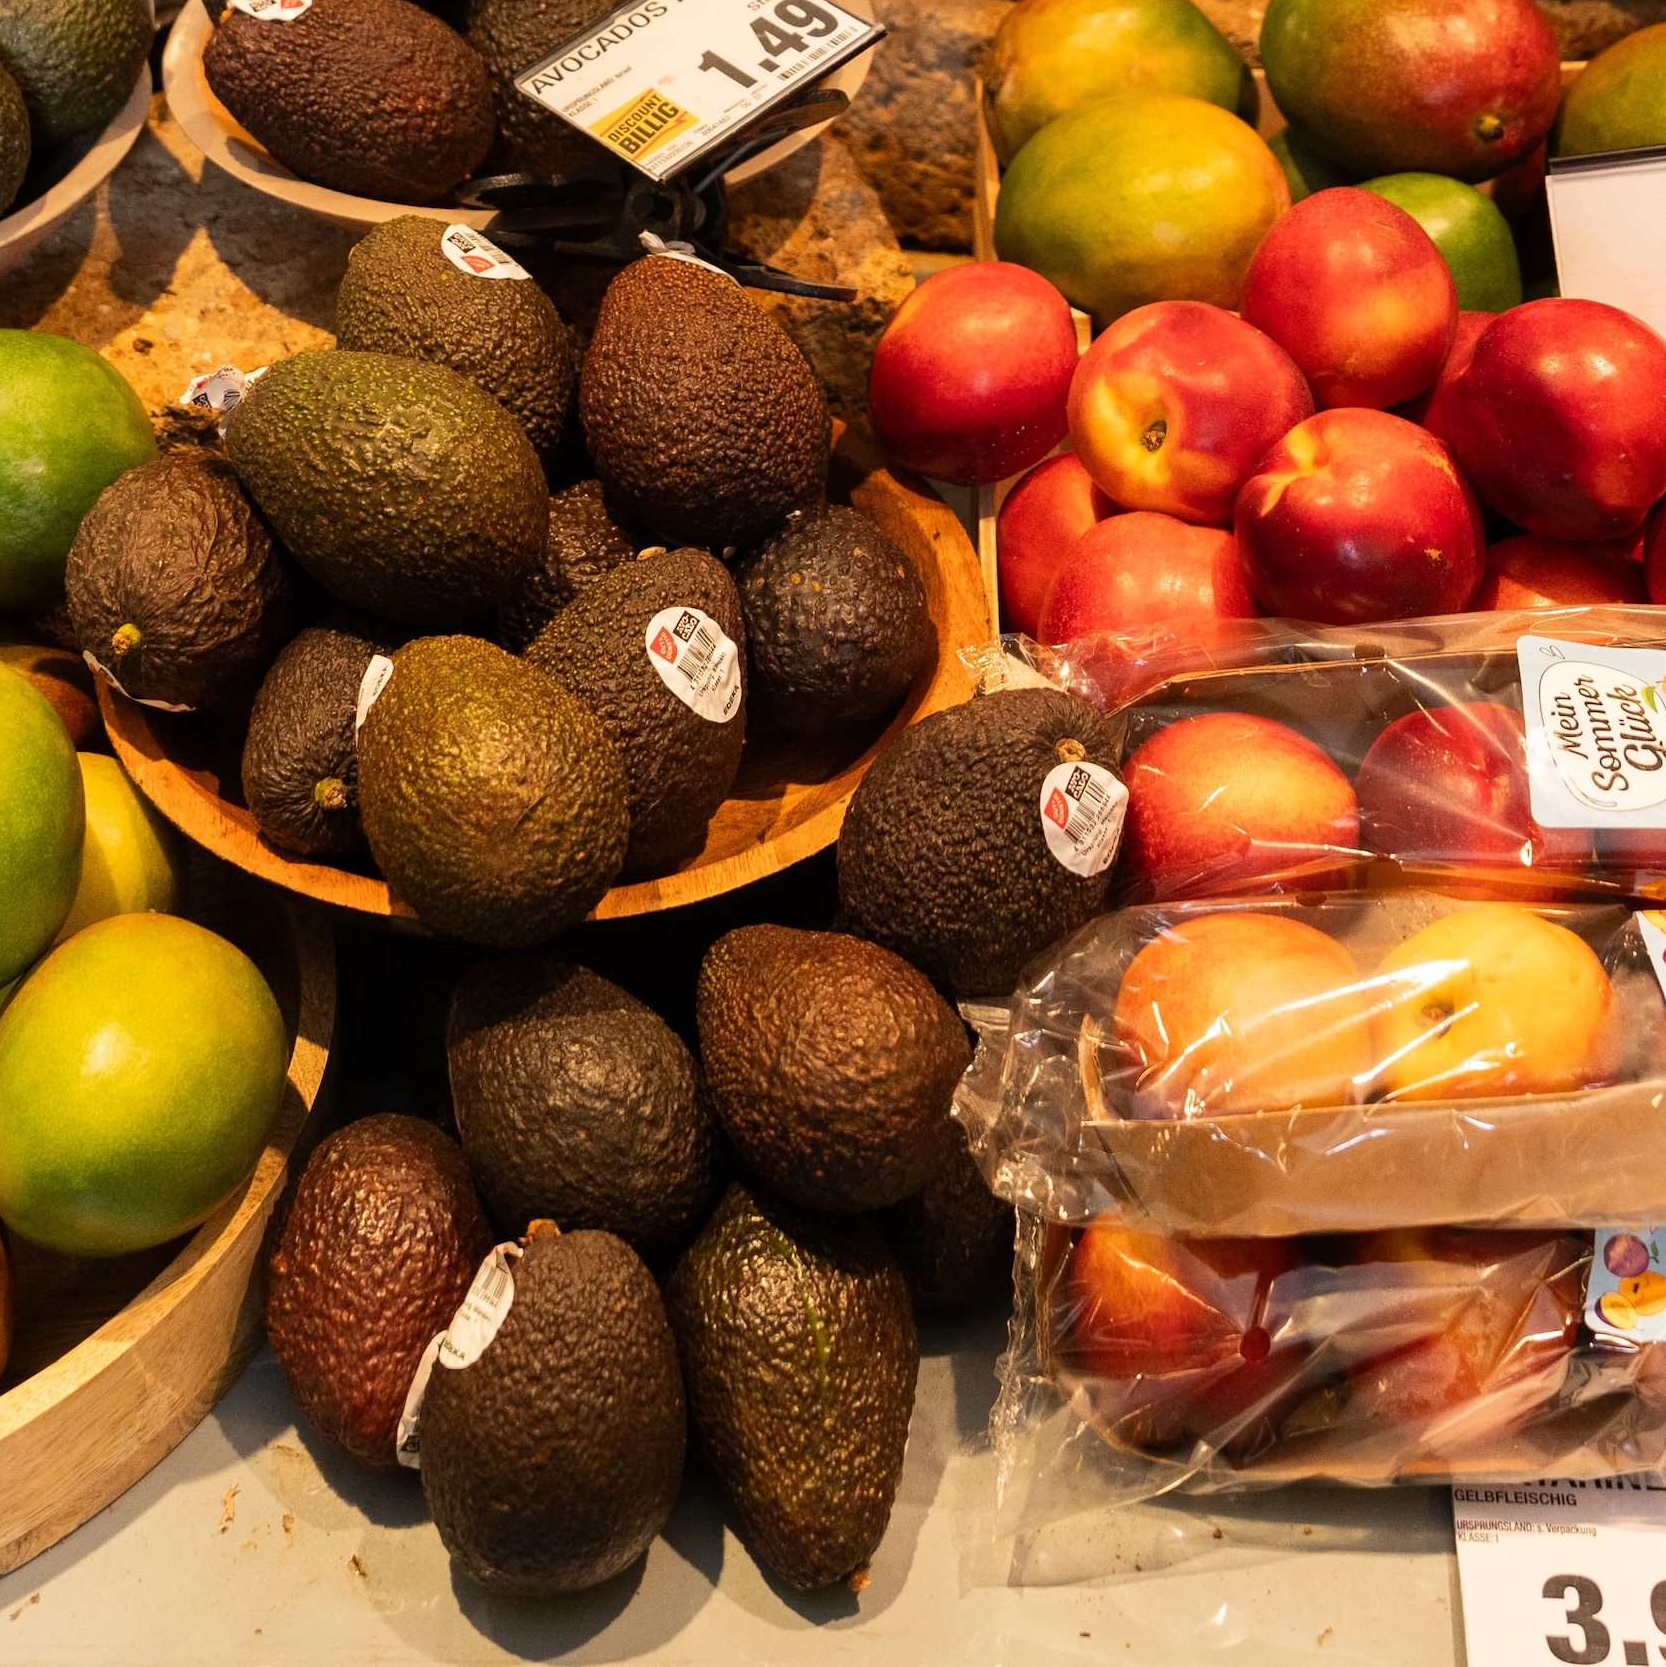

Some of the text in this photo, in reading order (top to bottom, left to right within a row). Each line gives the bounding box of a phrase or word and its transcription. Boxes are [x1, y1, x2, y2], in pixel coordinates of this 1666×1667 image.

[531, 0, 669, 96] AVOCADOS
[561, 75, 616, 114] URSPRUNGSLAND:
[607, 92, 663, 143] DISCOUNT
[617, 100, 681, 155] BILLIG
[723, 685, 740, 716] EDEKA
[1555, 690, 1589, 760] Mein
[1573, 674, 1630, 793] Sommer
[1453, 1489, 1578, 1507] GELBFLEISCHIG
[1456, 1518, 1536, 1534] URSPRUNGSLAND:
[1545, 1522, 1598, 1538] Verpackung
[1458, 1531, 1496, 1544] KLASSE:
